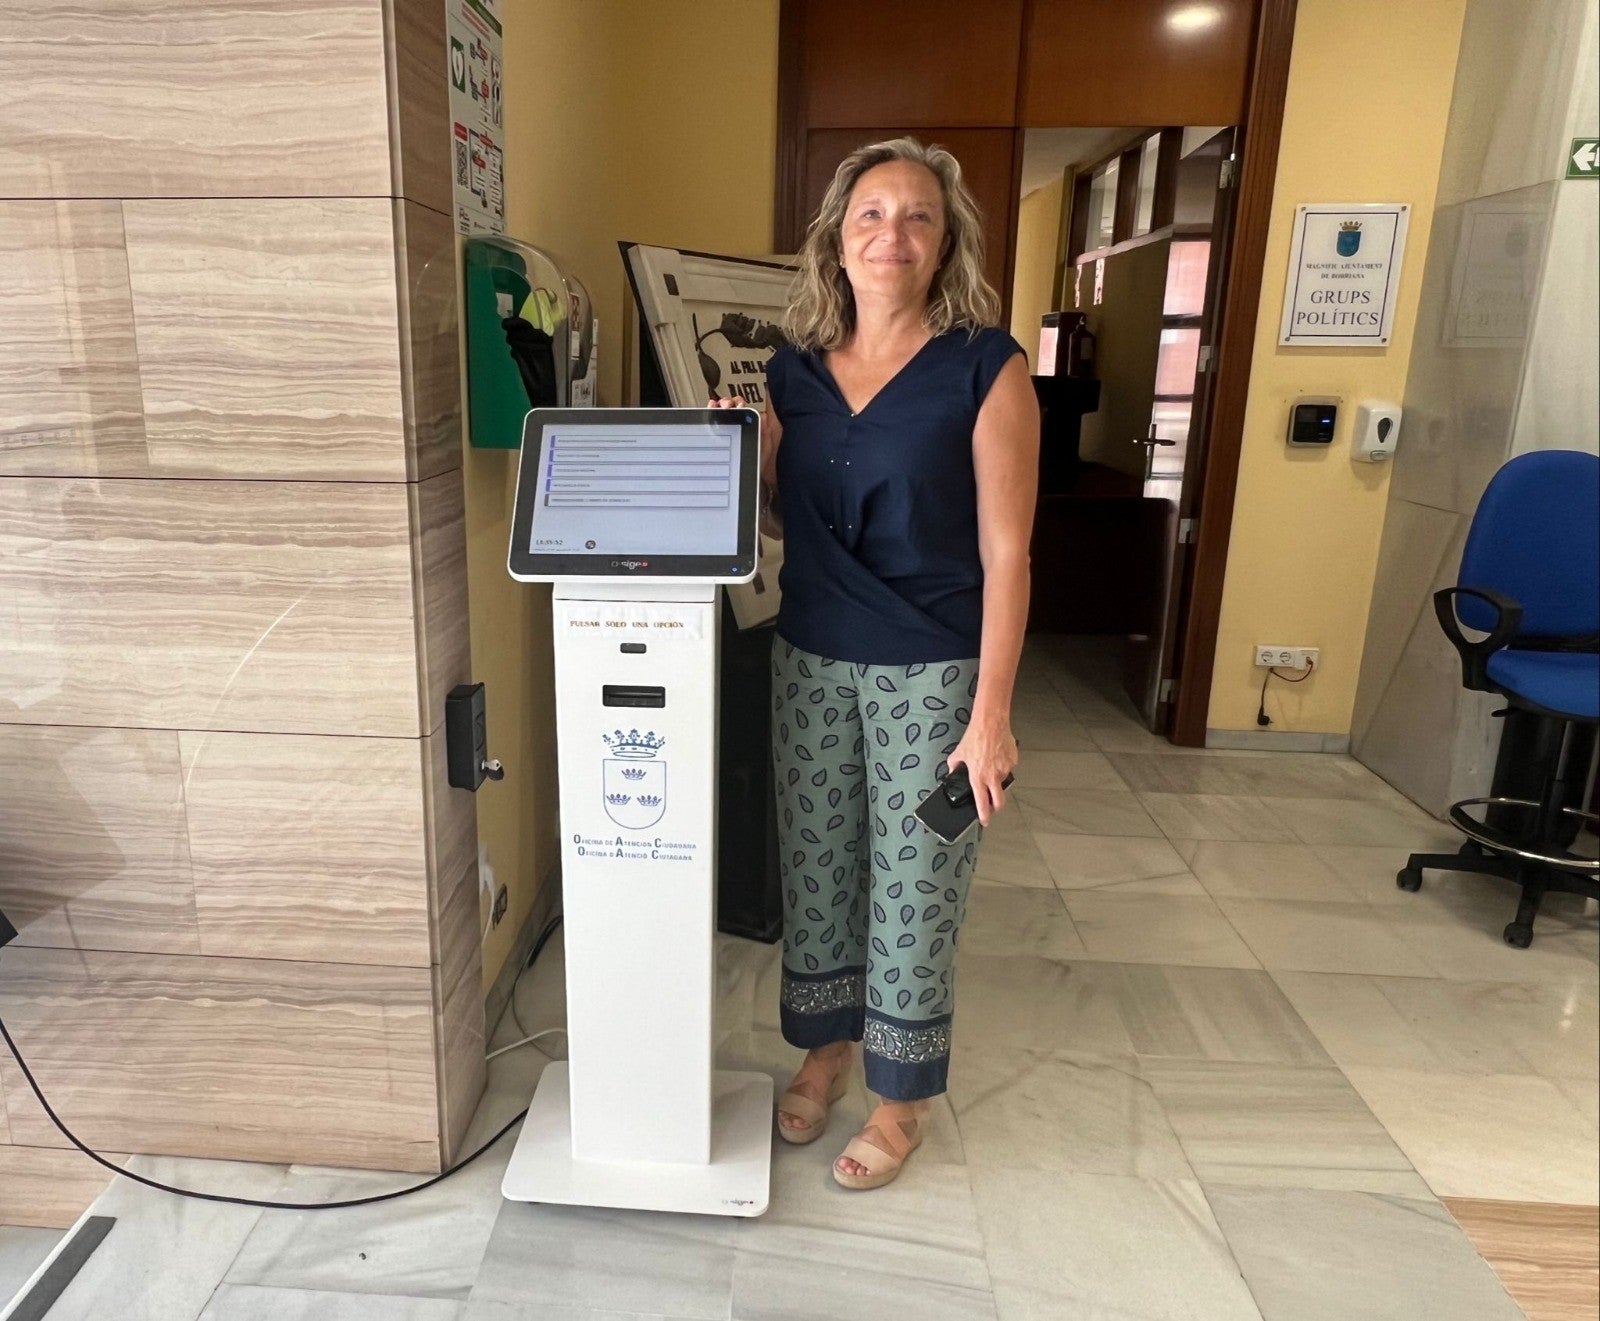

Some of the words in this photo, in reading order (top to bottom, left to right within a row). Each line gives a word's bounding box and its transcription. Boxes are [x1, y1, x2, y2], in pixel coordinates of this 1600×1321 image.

[1310, 290, 1371, 304] GRUPS
[1296, 308, 1379, 326] POLÍTICS
[570, 620, 600, 628] PULSAR
